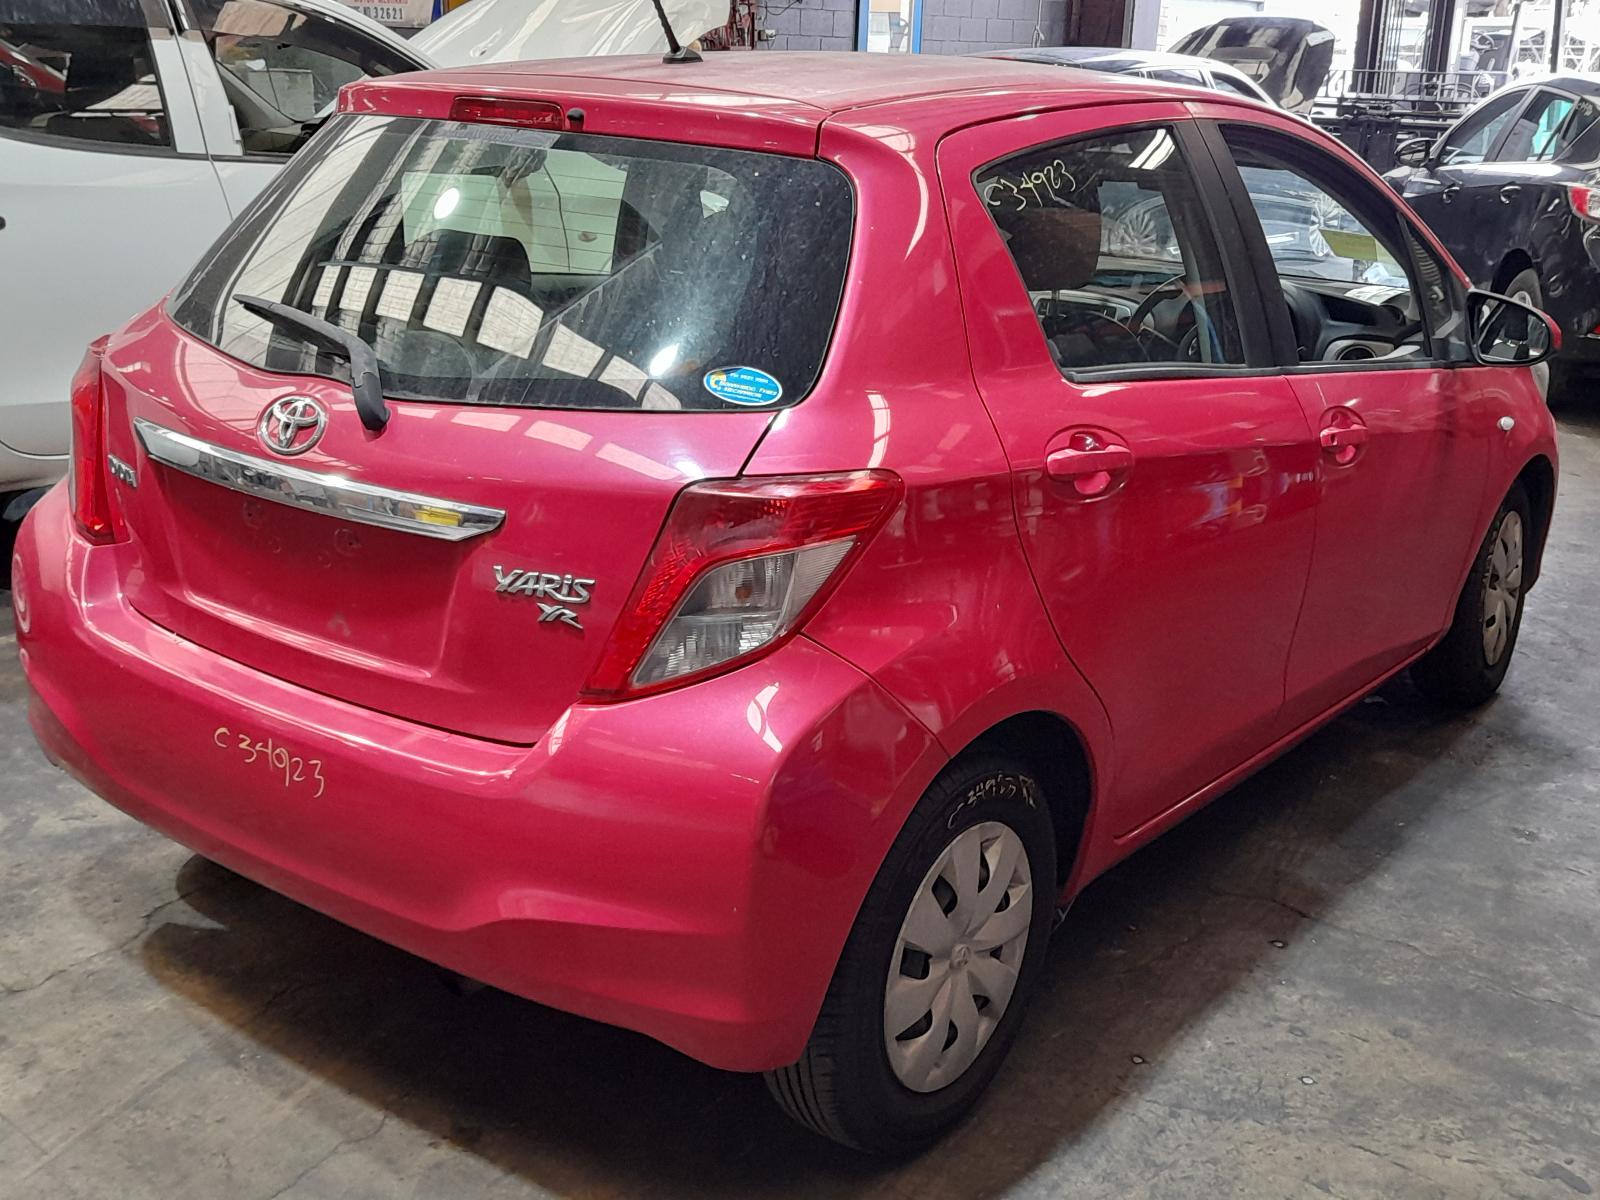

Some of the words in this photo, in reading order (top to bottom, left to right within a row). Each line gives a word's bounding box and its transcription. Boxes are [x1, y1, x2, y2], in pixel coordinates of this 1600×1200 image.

[373, 7, 403, 19] 32621
[984, 160, 1076, 211] C34923
[536, 602, 584, 630] YR
